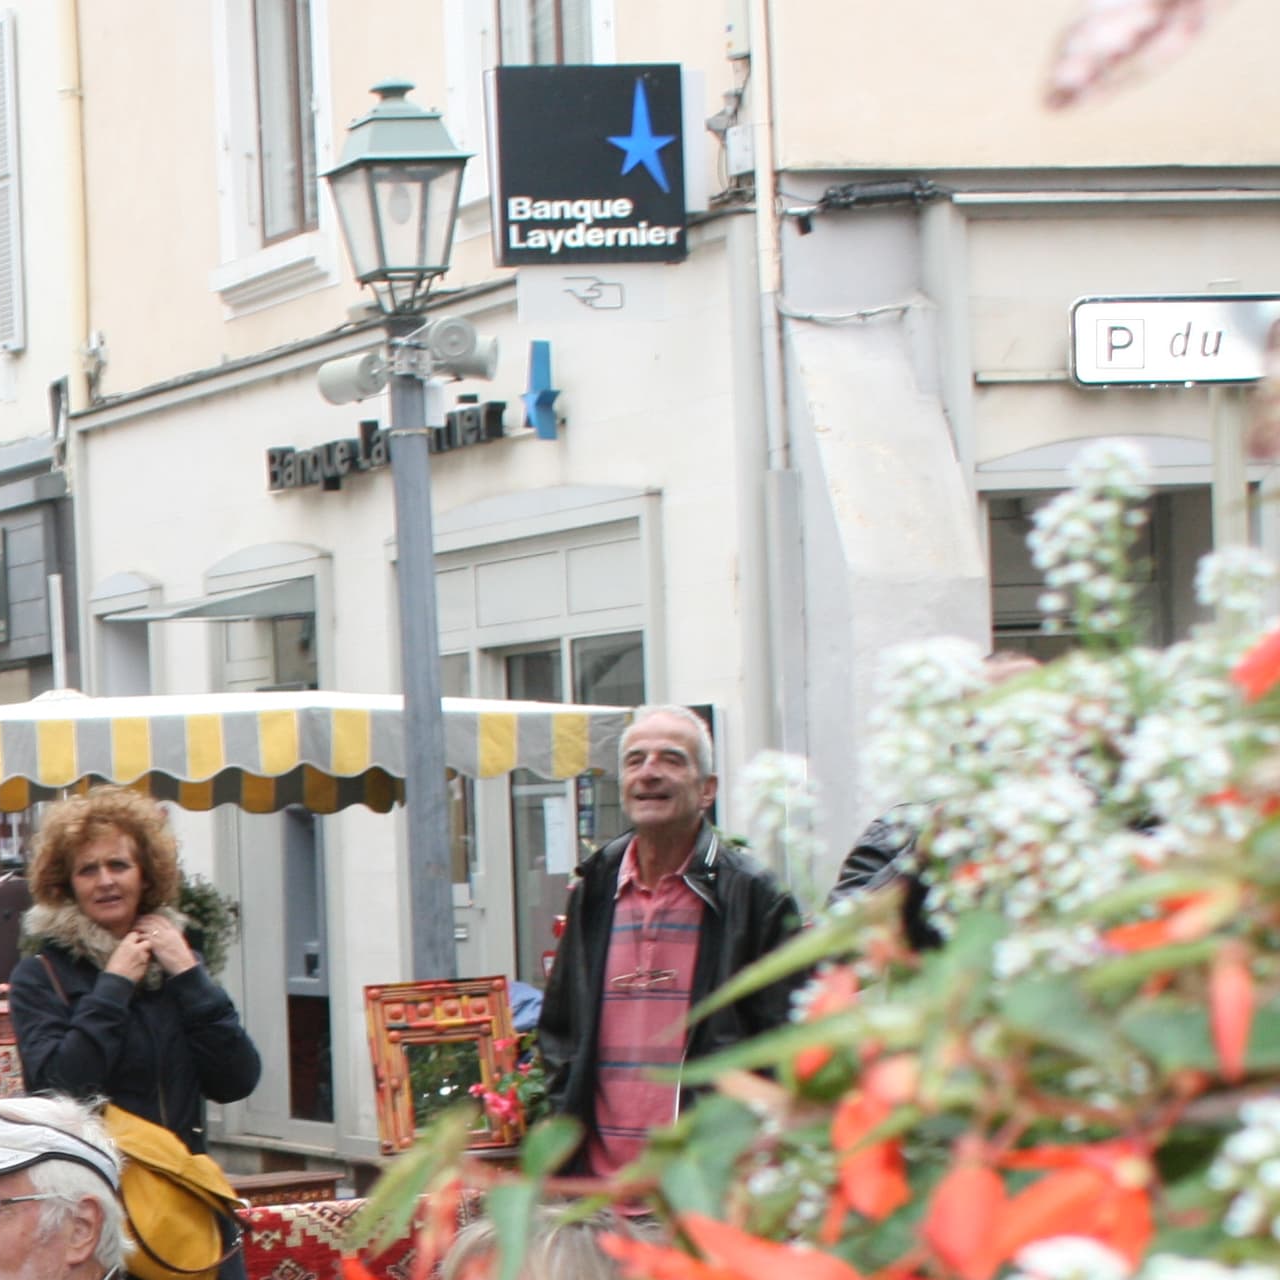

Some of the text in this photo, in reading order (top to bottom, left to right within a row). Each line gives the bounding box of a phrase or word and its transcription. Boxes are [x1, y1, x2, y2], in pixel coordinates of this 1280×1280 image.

[507, 196, 634, 224] Banque
[508, 221, 682, 254] Laydernier
[1169, 321, 1223, 358] du
[267, 446, 357, 491] Banque
